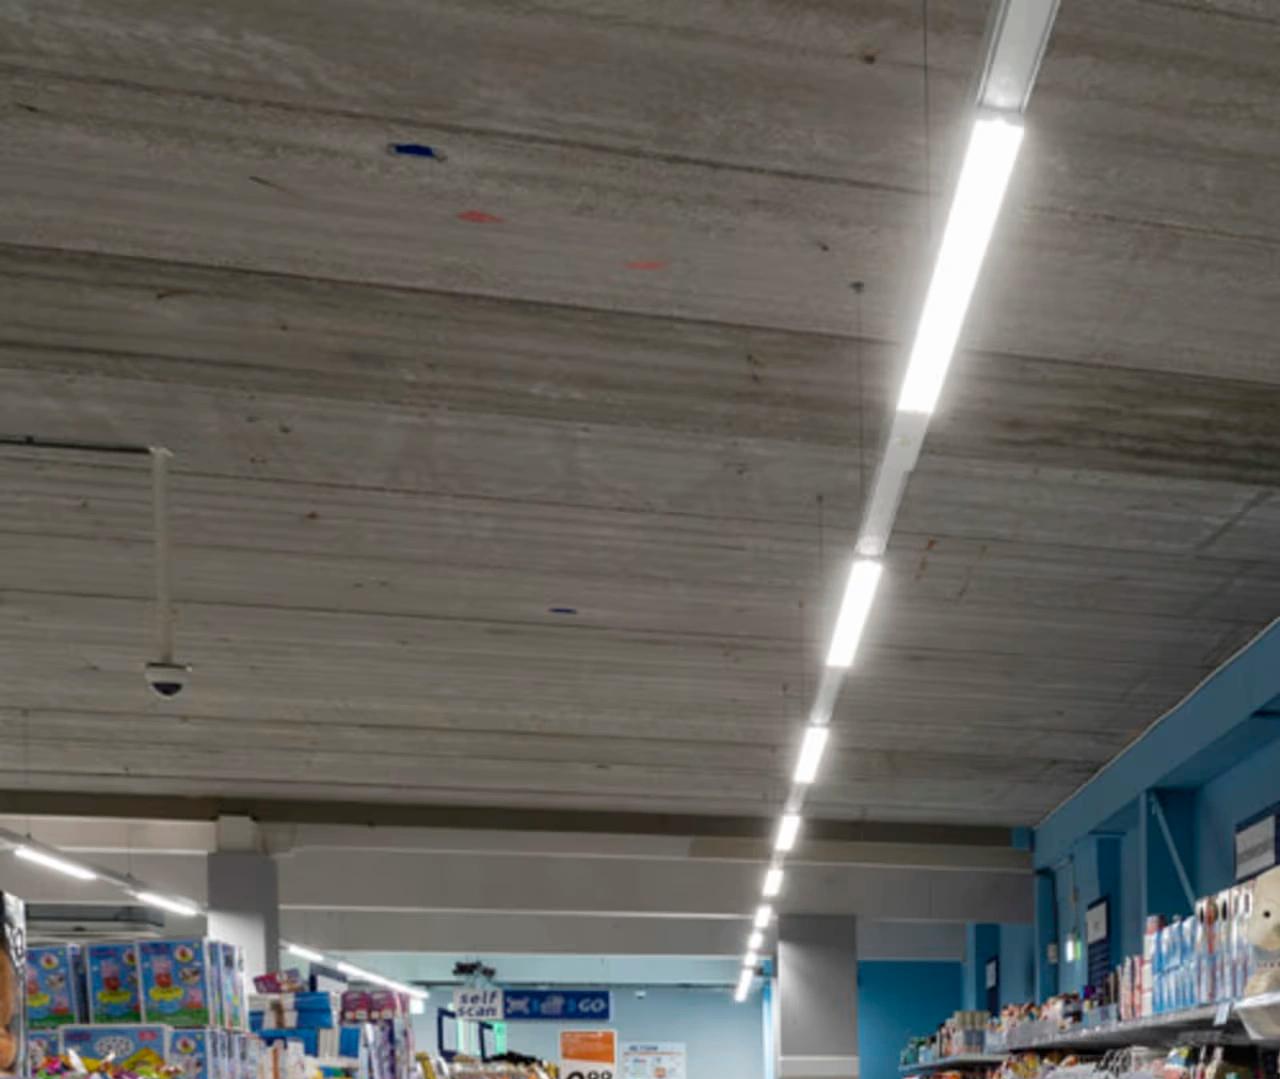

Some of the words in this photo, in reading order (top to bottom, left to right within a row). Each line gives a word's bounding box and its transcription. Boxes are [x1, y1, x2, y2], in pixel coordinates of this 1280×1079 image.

[460, 990, 498, 1004] self
[458, 1004, 498, 1018] scan
[578, 999, 605, 1012] GO
